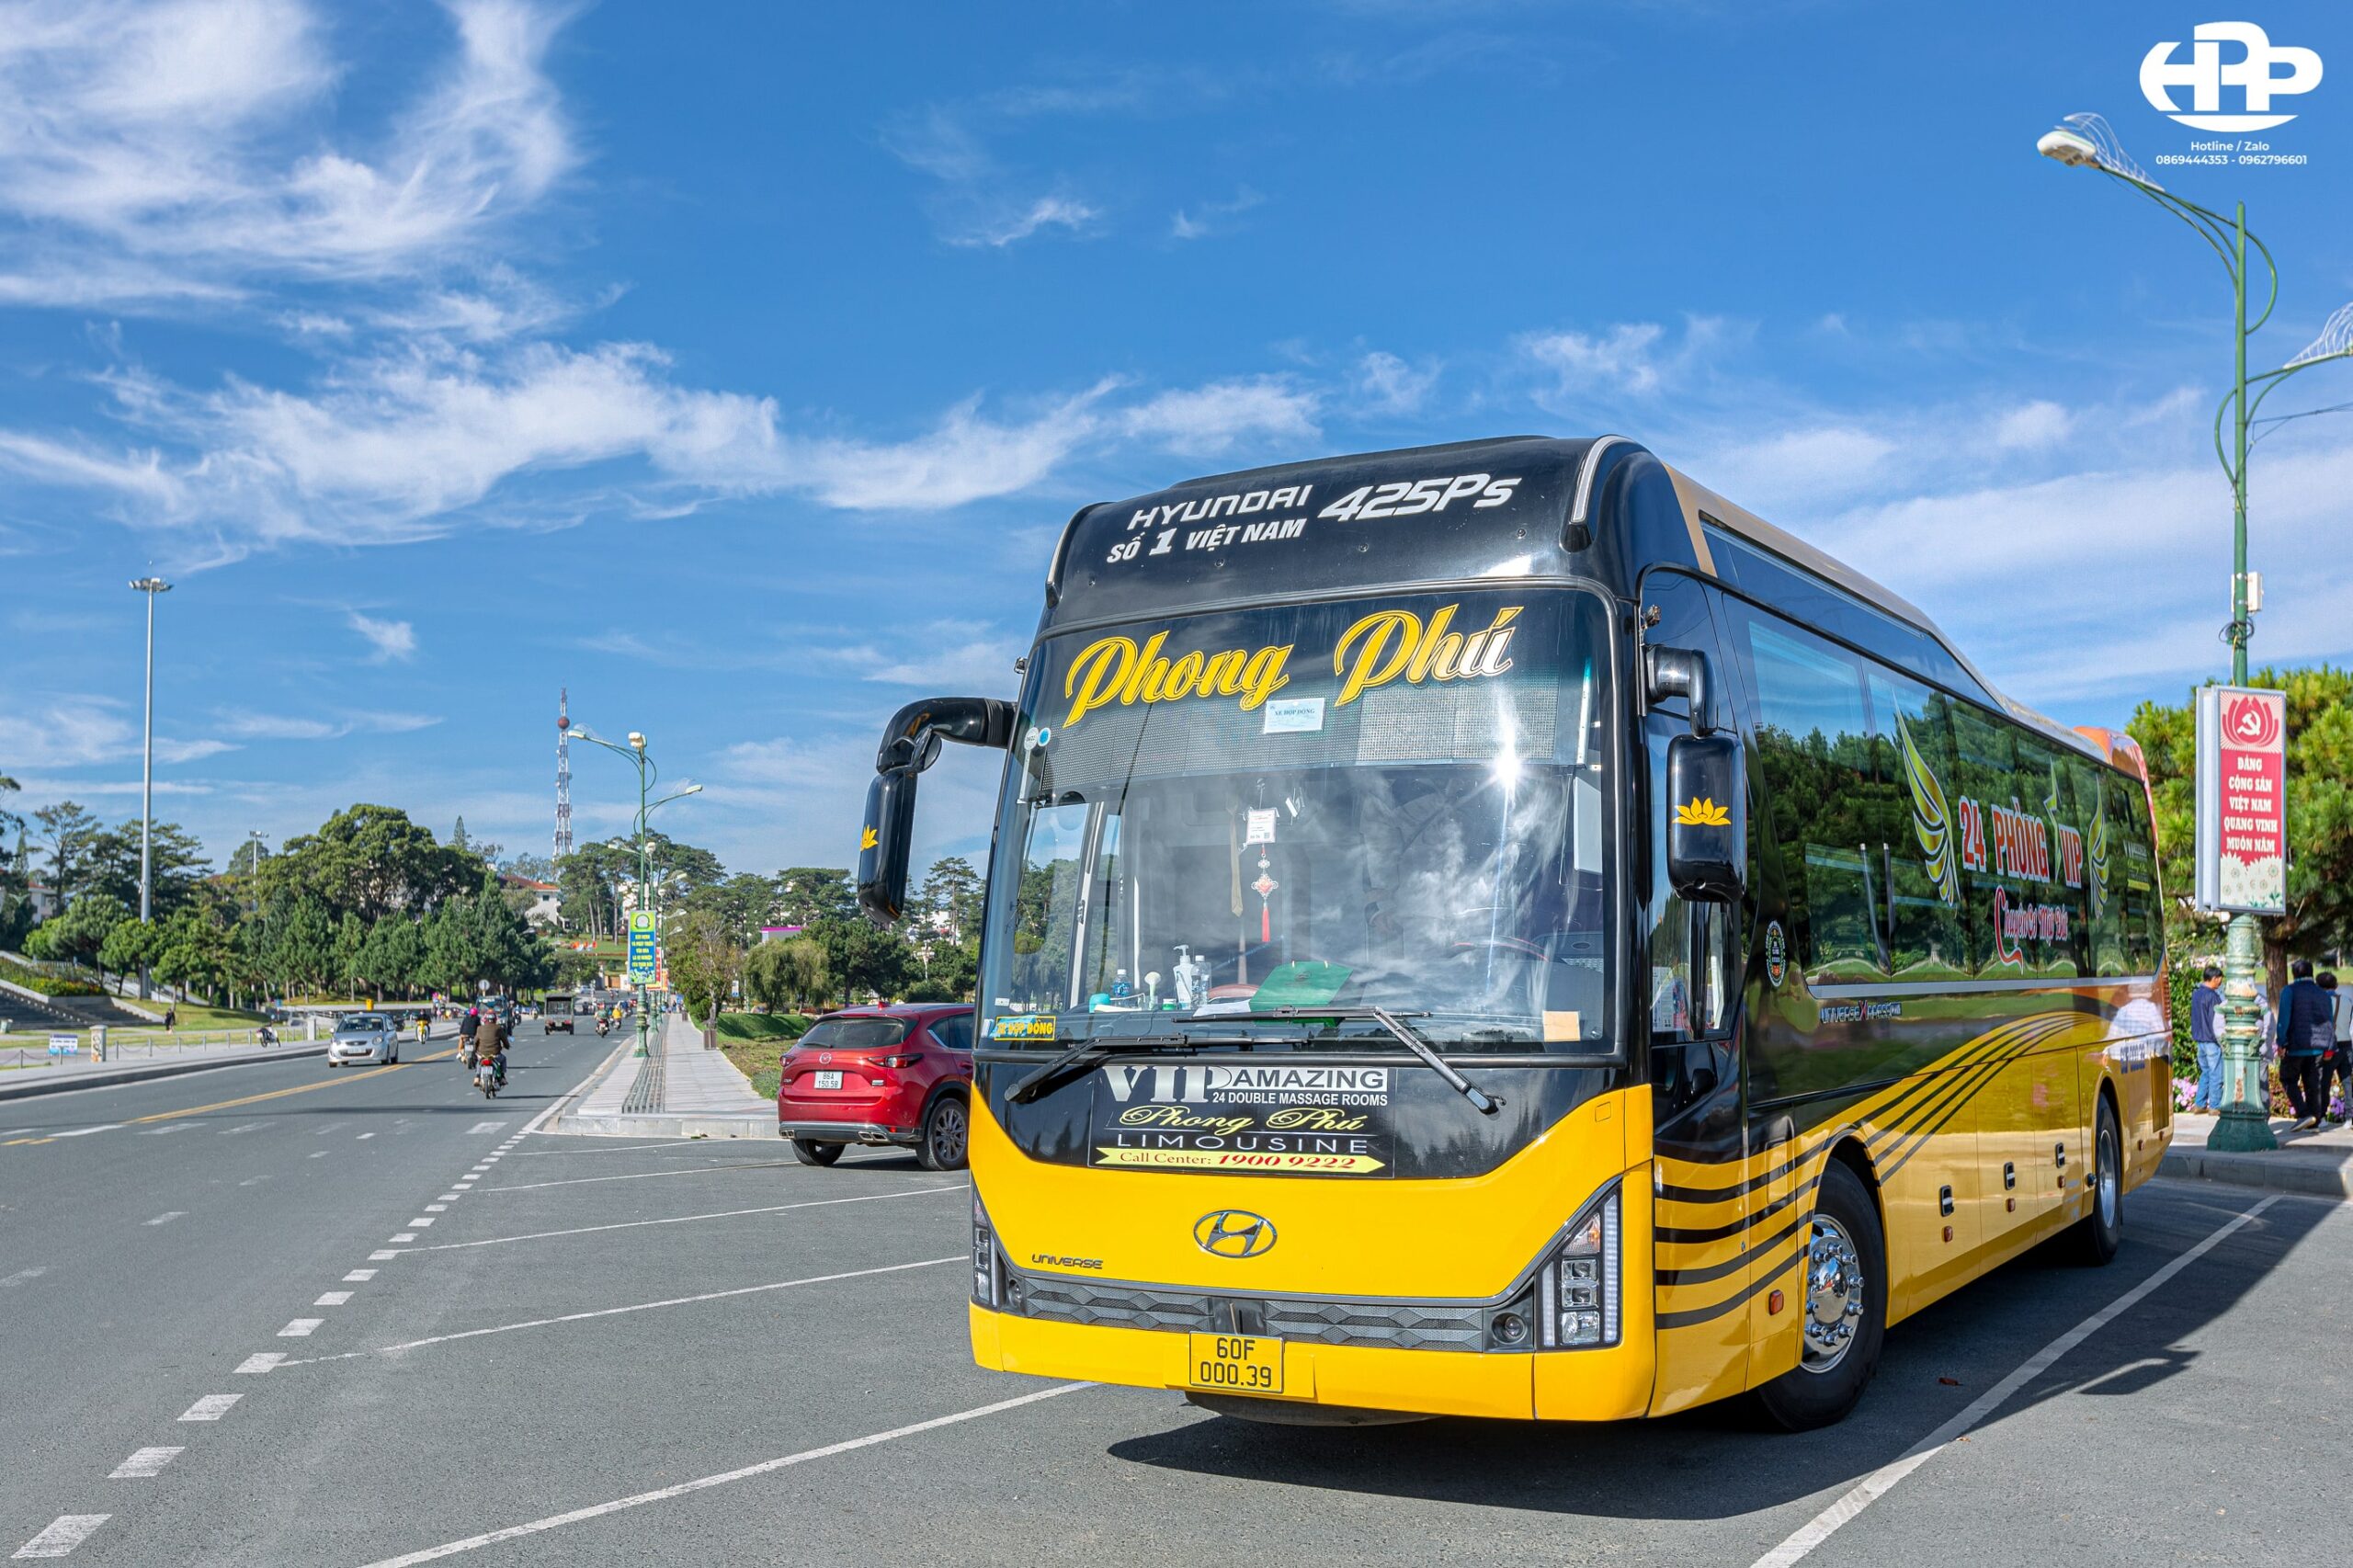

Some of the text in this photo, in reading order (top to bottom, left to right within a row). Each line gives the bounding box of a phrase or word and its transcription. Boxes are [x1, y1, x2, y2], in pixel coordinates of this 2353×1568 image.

[1127, 485, 1313, 530] HYUNDAI
[1317, 473, 1522, 522] 425Ps
[1106, 517, 1307, 563] SỐ 1 VIỆT NAM
[1063, 603, 1525, 729] Phong Phú
[2237, 755, 2263, 772] ĐẢNG
[2228, 774, 2273, 792] CỘNG SẢN
[2229, 794, 2272, 813] VIỆT NAM
[2224, 816, 2279, 833] QUANG VINH
[1959, 795, 2084, 889] 24 PHÒNG VIP
[2226, 835, 2276, 853] MUÔN NĂM
[1233, 1069, 1383, 1089] AMAZING
[1212, 1092, 1388, 1107] 24 DOUBLE MASSAGE ROOMS
[1119, 1105, 1368, 1136] Phong Phú
[1117, 1133, 1368, 1154] LIMOUSINE
[1120, 1152, 1357, 1170] Call Center: 1900 9222
[1031, 1253, 1104, 1270] UNIVERSE
[1216, 1336, 1256, 1361] 60F
[1199, 1360, 1272, 1389] 000.39
